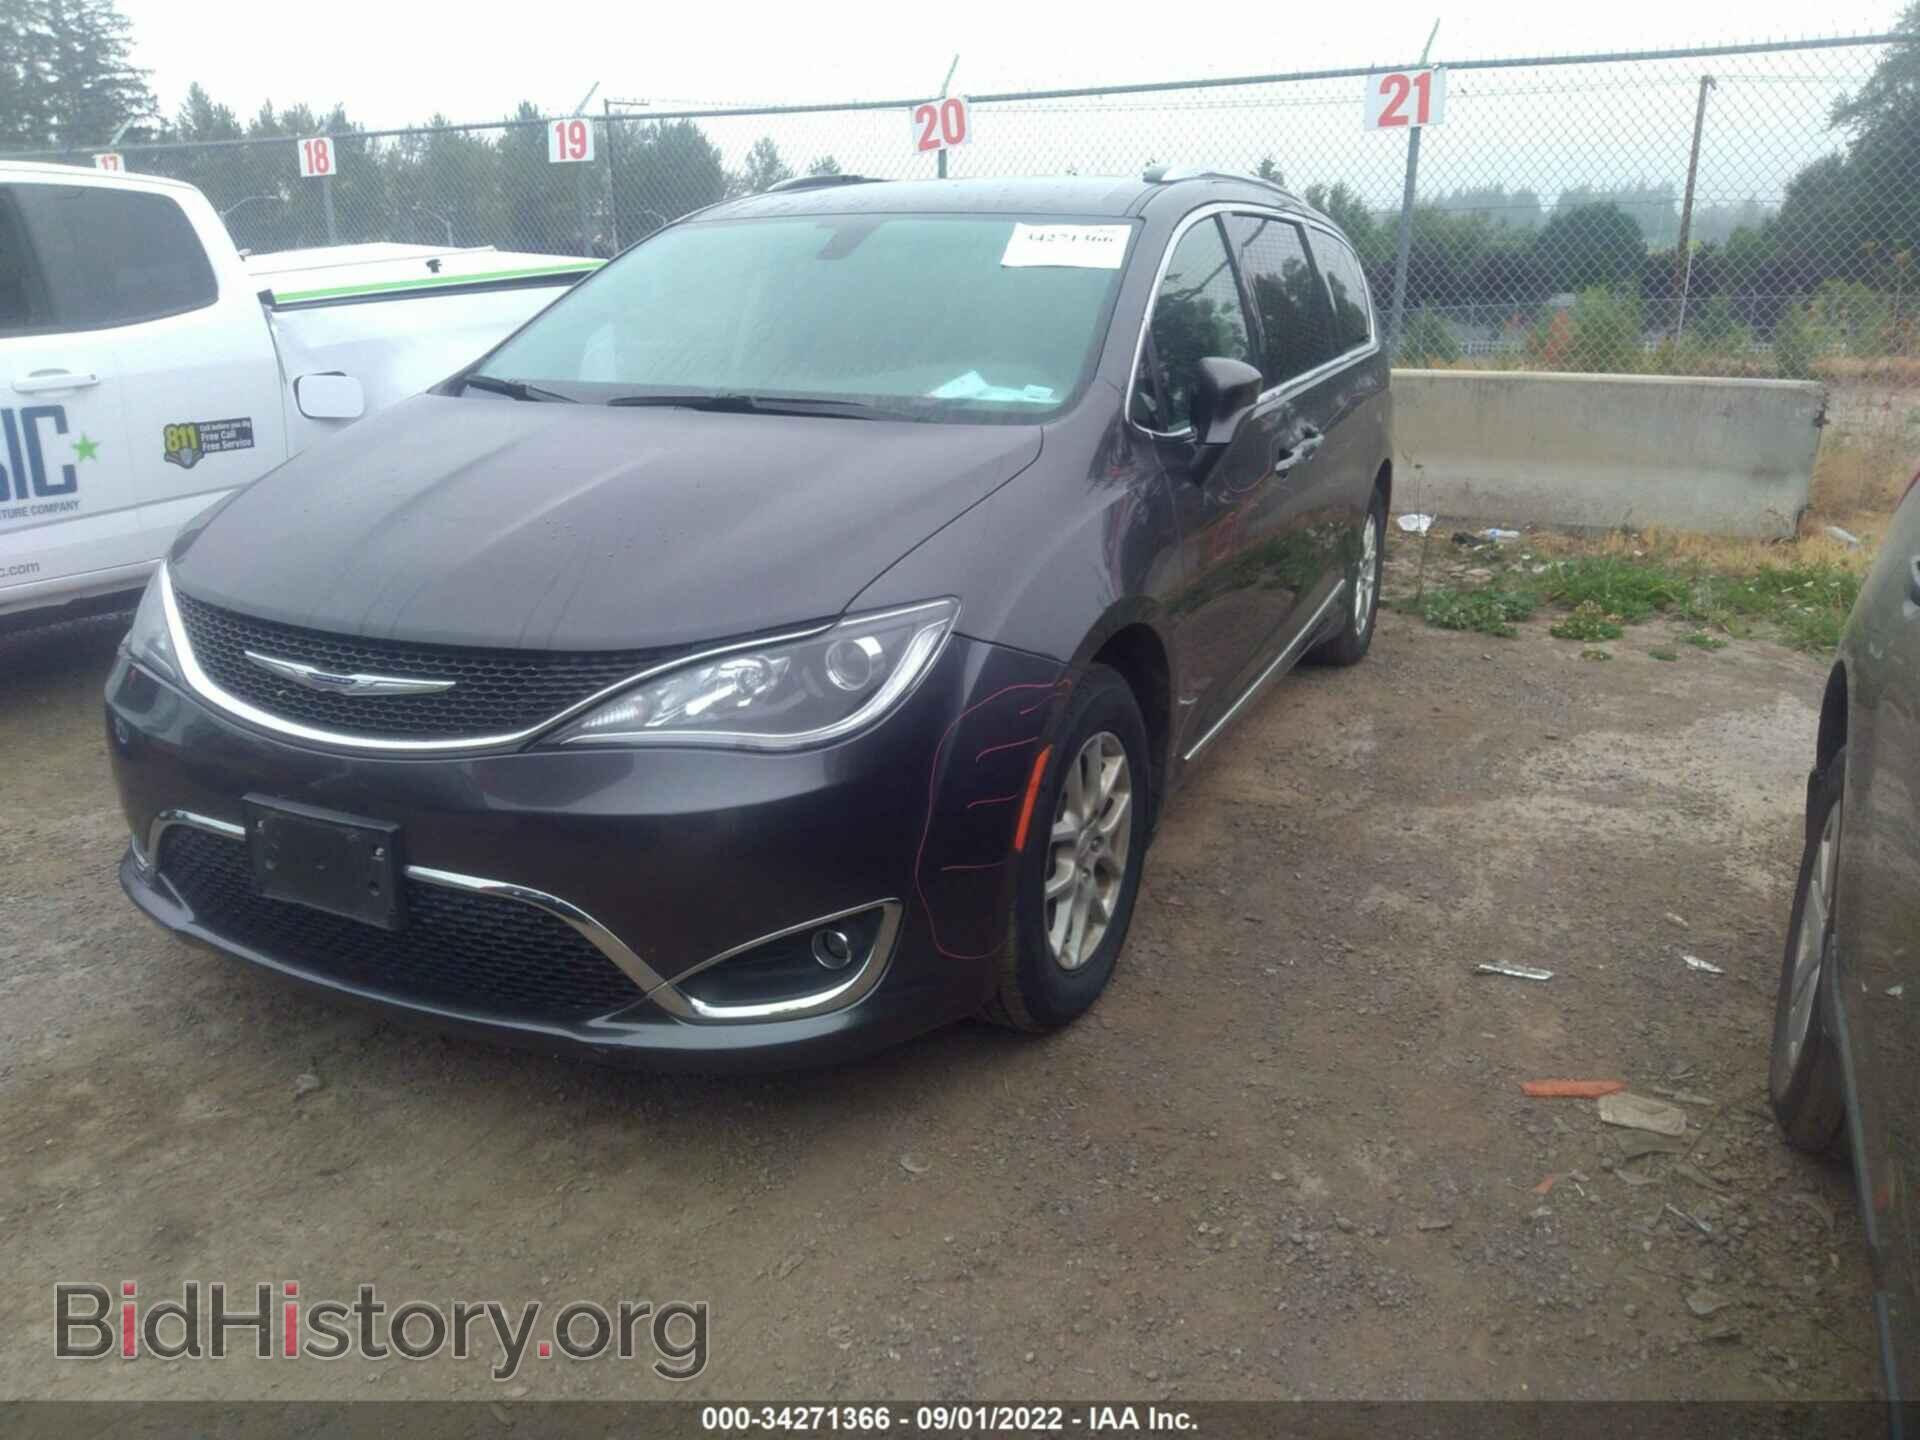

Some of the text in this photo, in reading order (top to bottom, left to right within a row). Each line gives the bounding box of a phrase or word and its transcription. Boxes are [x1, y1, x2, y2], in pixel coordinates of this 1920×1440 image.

[1378, 71, 1431, 127] 21
[555, 120, 586, 160] 19
[915, 98, 966, 152] 20
[303, 139, 329, 174] 18
[0, 404, 78, 502] IC
[165, 423, 198, 453] 811
[200, 430, 237, 442] Free Call
[202, 439, 251, 452] Free Service
[31, 501, 80, 515] COMPANY
